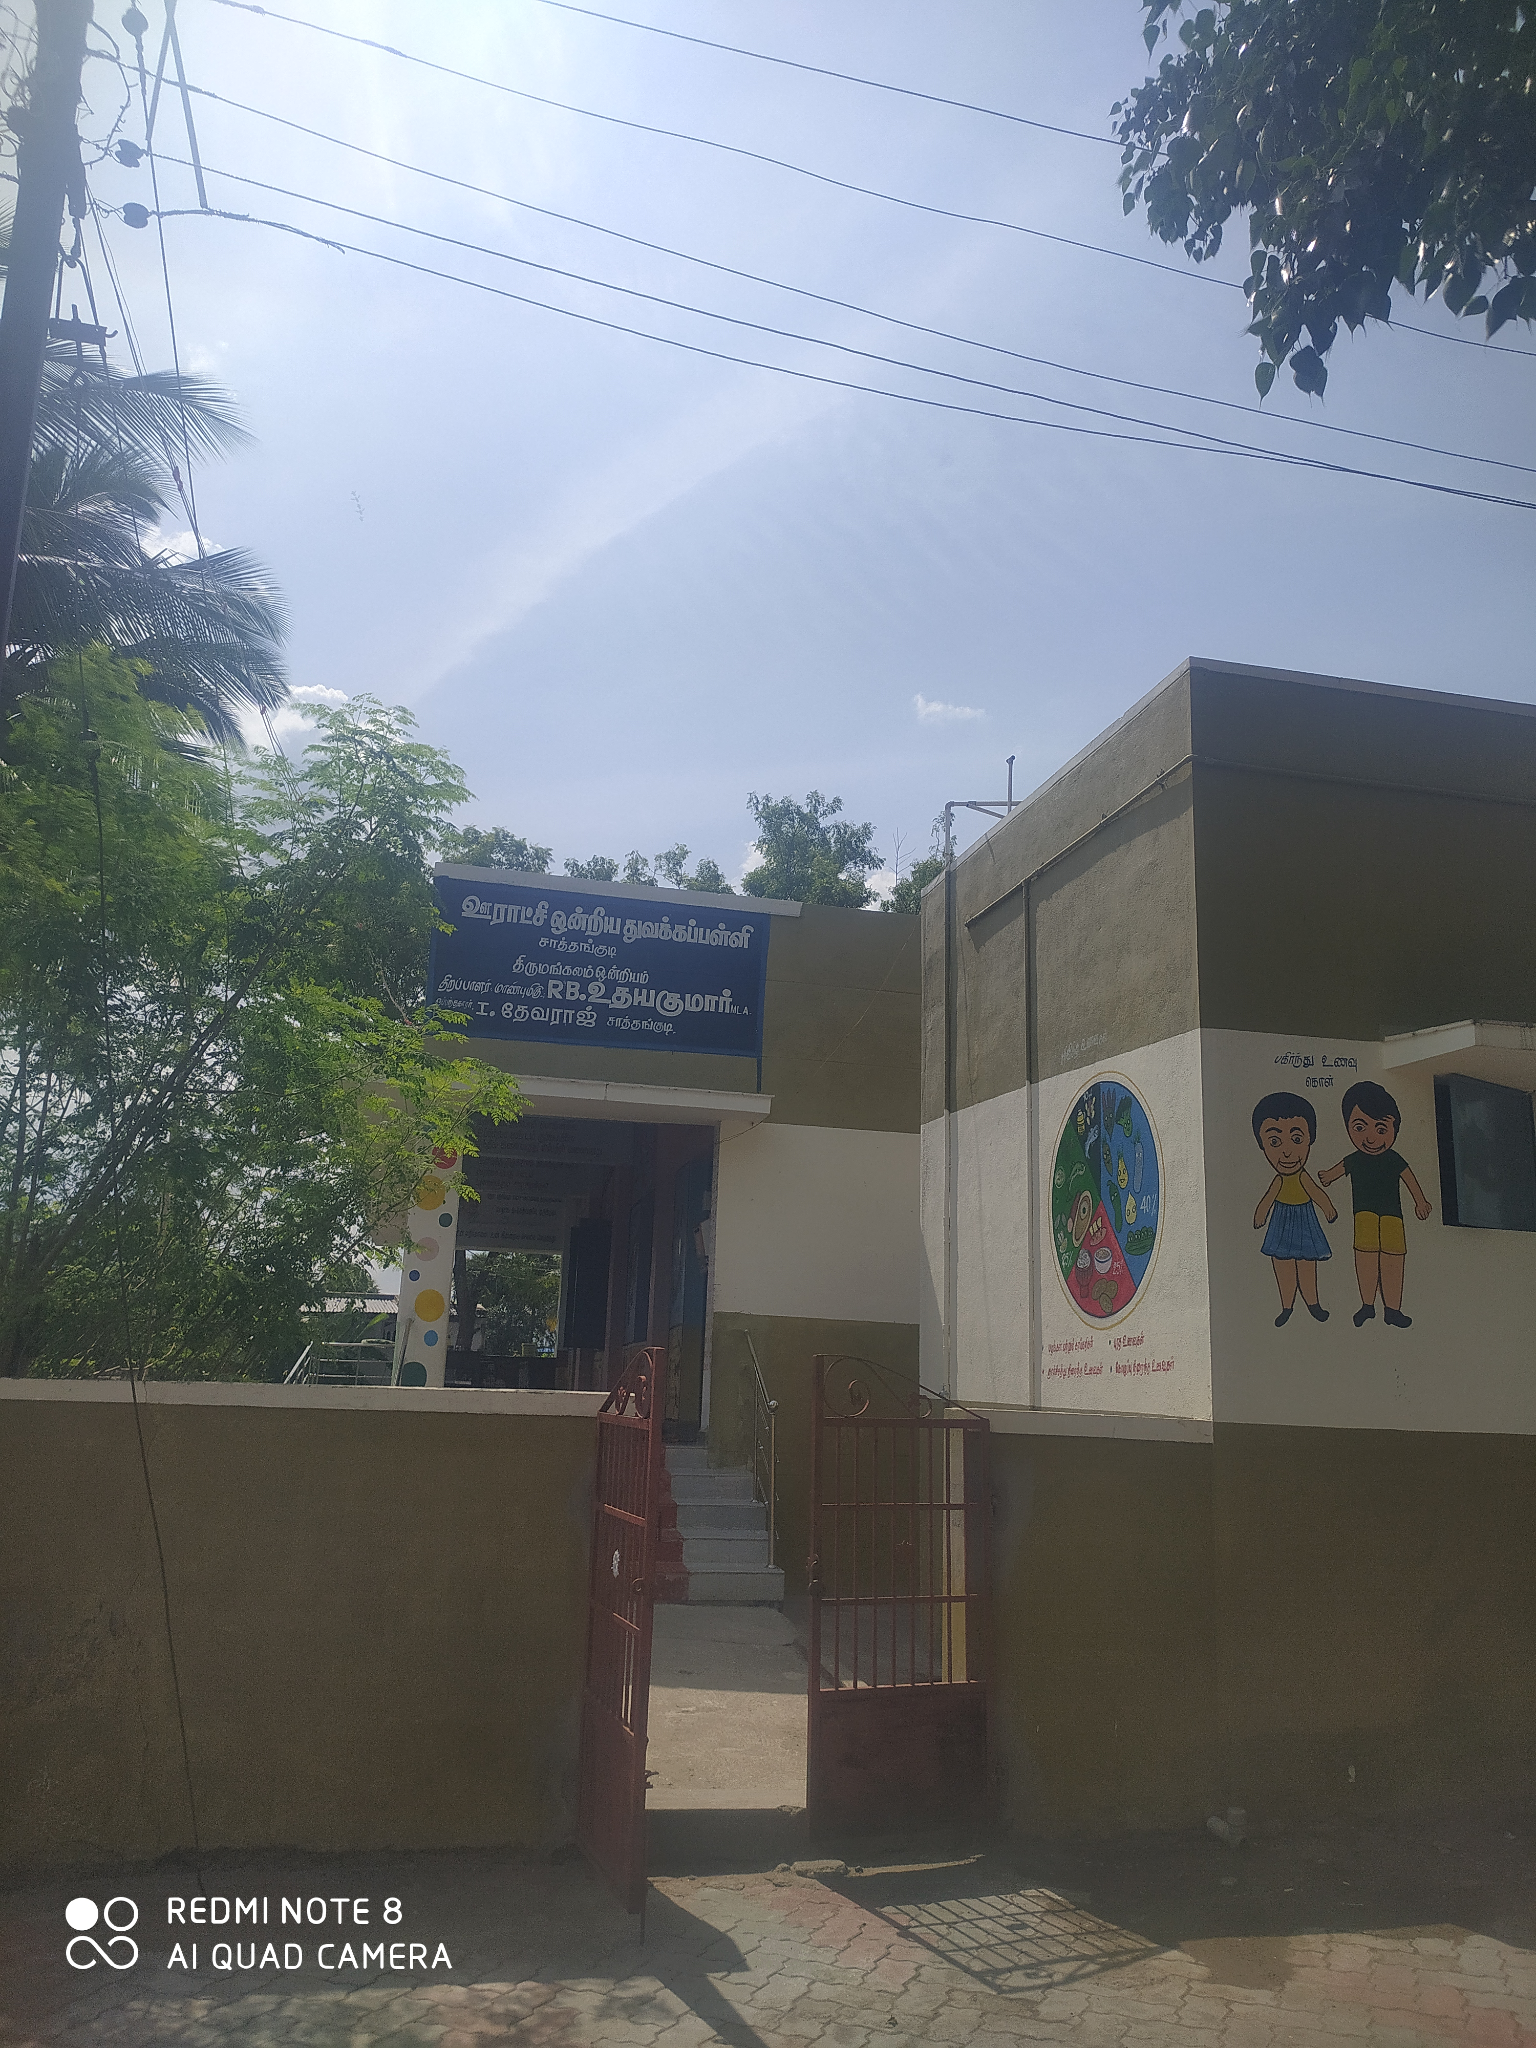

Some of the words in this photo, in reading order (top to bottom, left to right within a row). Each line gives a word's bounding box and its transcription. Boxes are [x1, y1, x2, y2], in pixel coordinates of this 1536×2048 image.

[461, 895, 549, 927] ஊராட்சி
[550, 906, 621, 937] ஒன்றிய
[623, 916, 754, 950] துவக்கப்பள்ளி
[538, 936, 617, 959] சாத்தங்குடி
[512, 955, 594, 978] திருமங்கலம்
[596, 965, 649, 985] ஒன்றியம்
[501, 1001, 597, 1029] தேவராஜ்
[1274, 1051, 1315, 1068] பகிர்ந்து
[1322, 1055, 1358, 1073] உணவு
[1140, 1193, 1158, 1217] 40%
